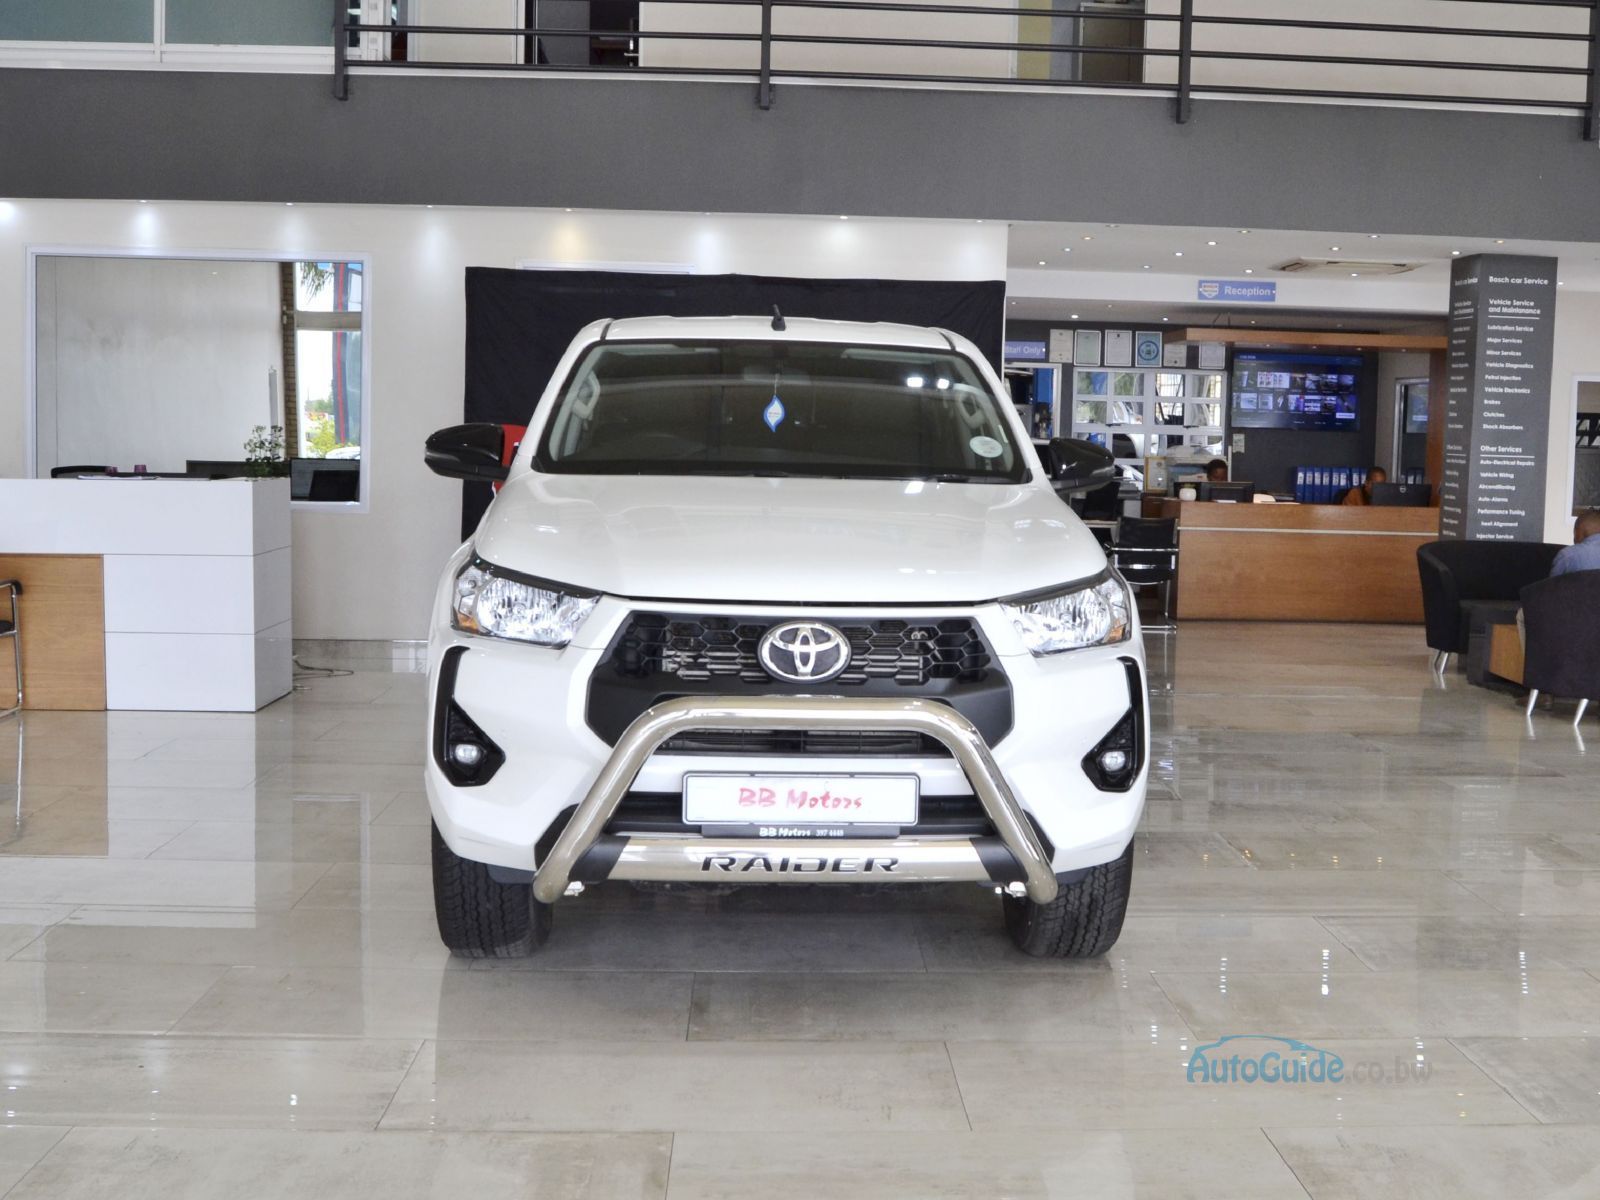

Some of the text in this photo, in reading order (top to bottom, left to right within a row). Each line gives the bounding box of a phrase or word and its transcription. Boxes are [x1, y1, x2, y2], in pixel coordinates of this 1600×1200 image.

[1524, 277, 1548, 285] Service
[1224, 286, 1270, 296] Reception
[738, 788, 862, 809] BB Motors
[760, 828, 777, 836] BB
[778, 828, 810, 836] Motors
[702, 856, 898, 872] RAIDER
